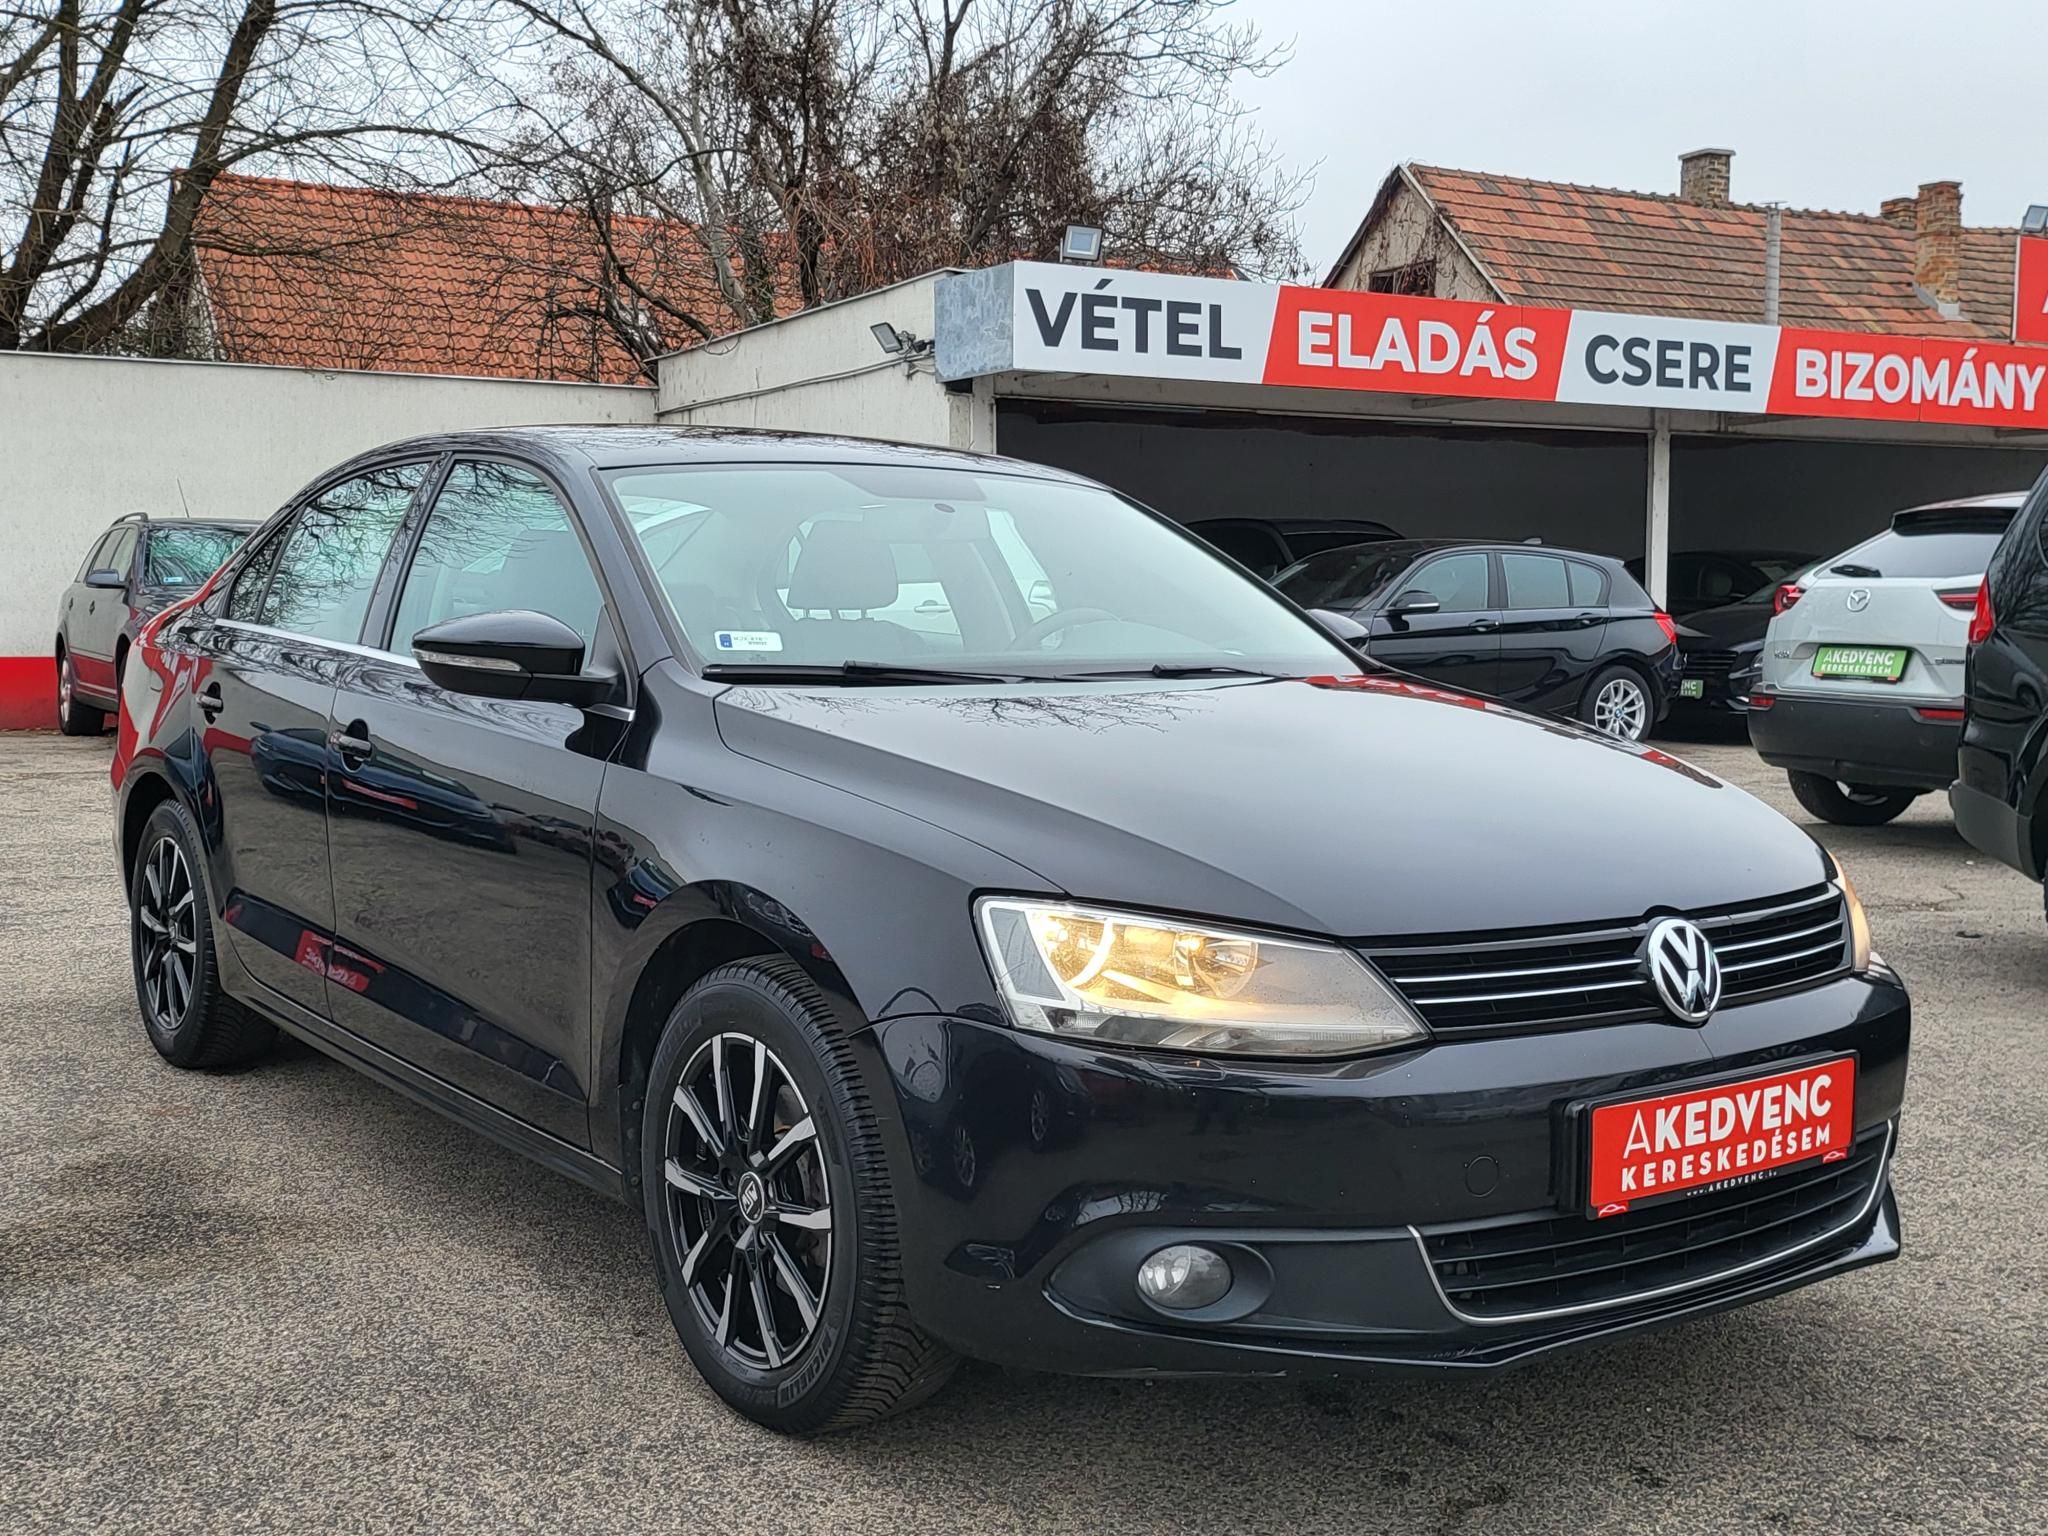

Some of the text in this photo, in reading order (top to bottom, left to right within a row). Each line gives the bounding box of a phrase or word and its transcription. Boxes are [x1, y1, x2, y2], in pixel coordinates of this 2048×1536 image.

[1025, 278, 2046, 411] VÉTEL ELADÁS CSERE BIZOMÁNY
[1823, 649, 1895, 666] AKEDVENC
[1623, 1074, 1832, 1159] AKEDVENC
[1621, 1122, 1831, 1193] KERESKEDÉSEM
